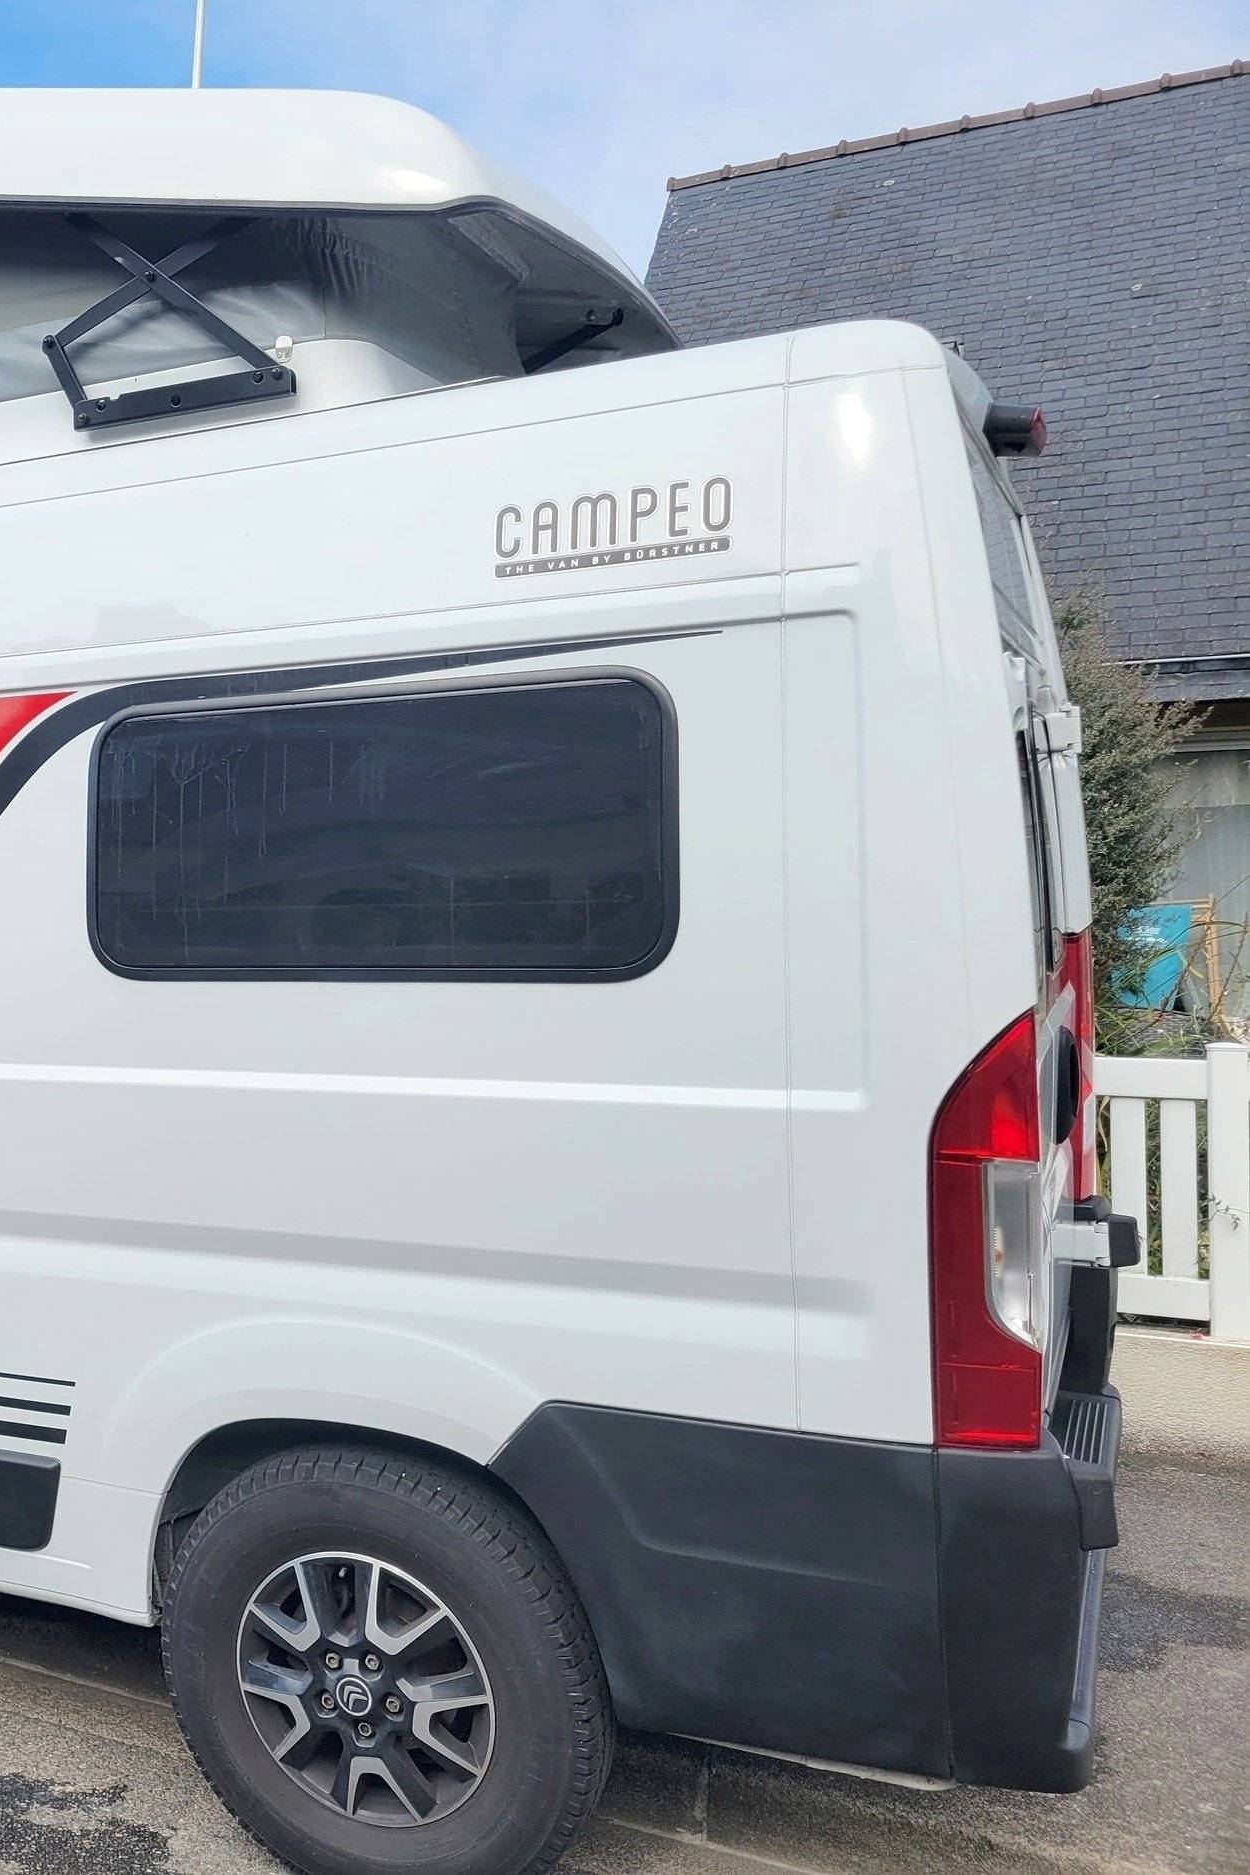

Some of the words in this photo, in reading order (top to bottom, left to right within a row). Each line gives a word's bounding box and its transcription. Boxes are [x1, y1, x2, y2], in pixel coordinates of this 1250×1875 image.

[495, 476, 731, 558] CAMPEO
[504, 564, 535, 575] THE
[547, 558, 579, 570] VAN
[591, 554, 611, 566] BY
